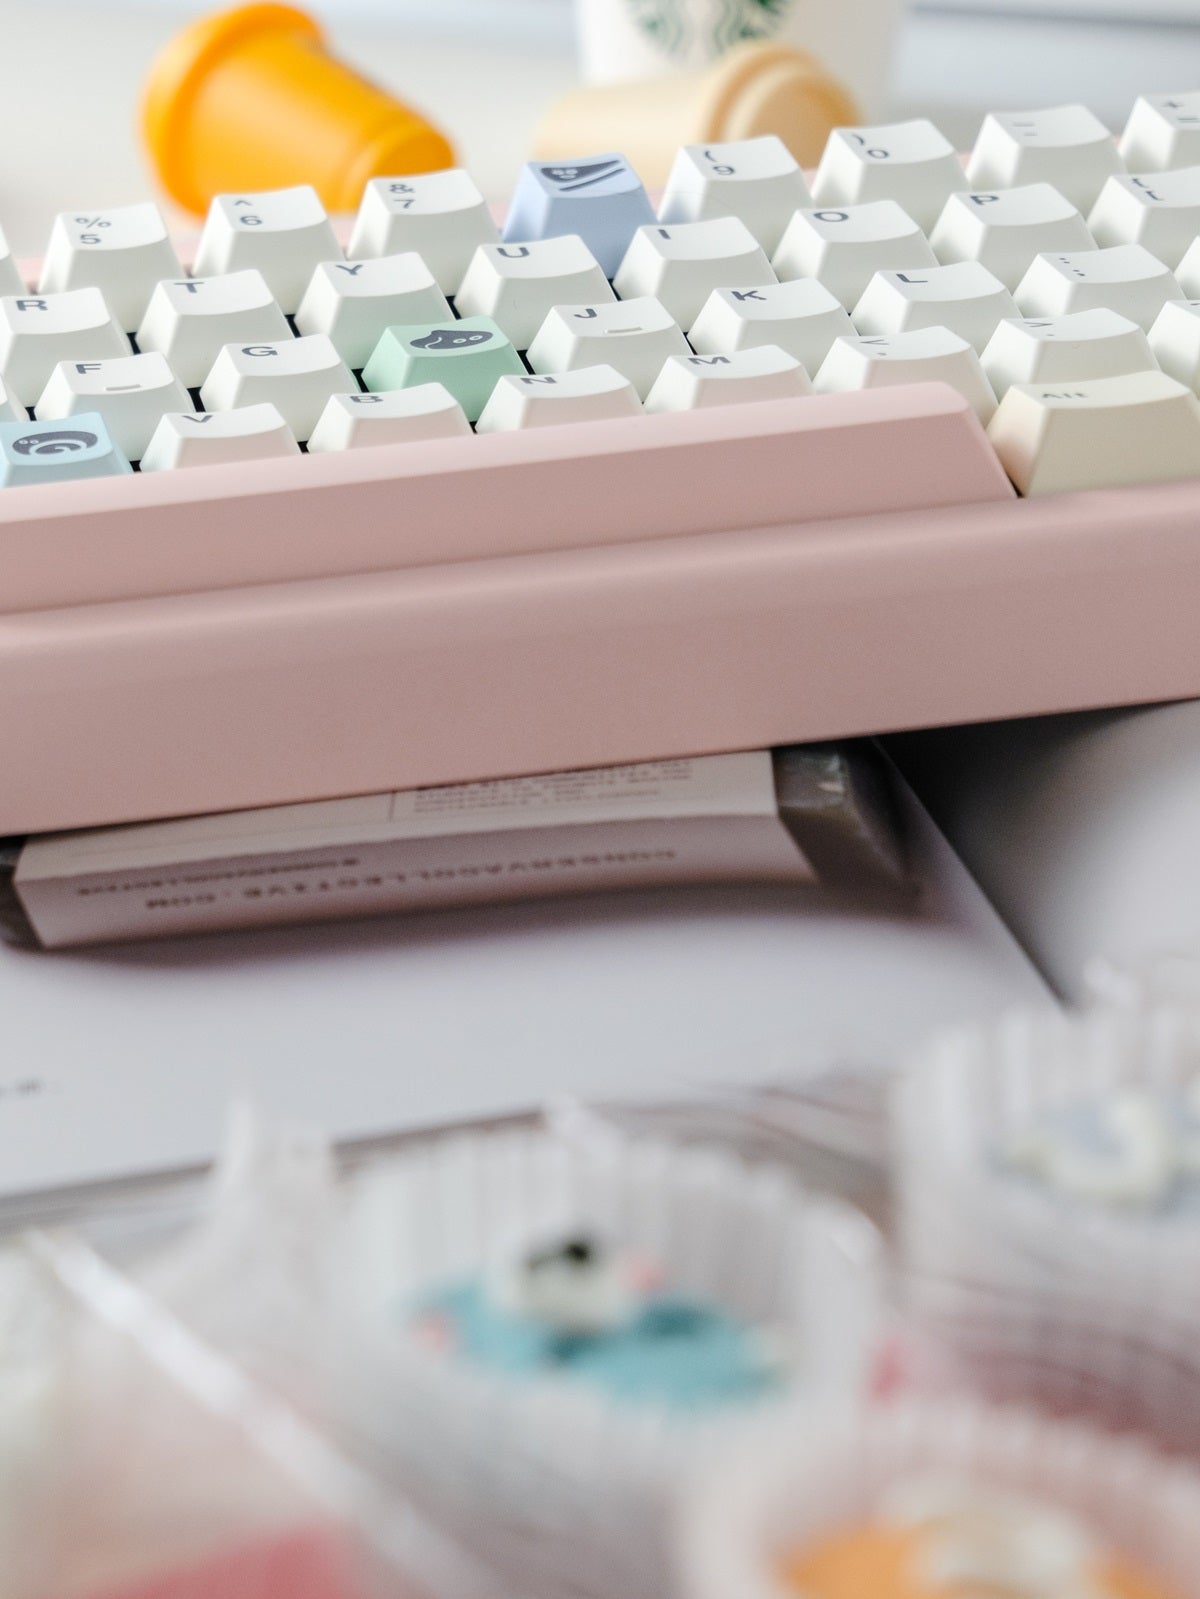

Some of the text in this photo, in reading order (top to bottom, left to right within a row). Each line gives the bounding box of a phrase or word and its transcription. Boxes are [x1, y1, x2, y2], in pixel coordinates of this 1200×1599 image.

[711, 165, 736, 176] 9
[388, 183, 414, 194] &
[393, 198, 415, 209] 7
[969, 195, 1000, 206] P
[239, 215, 263, 226] 6
[812, 211, 850, 223] O
[74, 217, 112, 230] %
[79, 233, 102, 245] 5
[656, 228, 671, 240] I
[495, 246, 530, 259] U
[335, 264, 365, 277] Y
[895, 272, 930, 284] L
[173, 281, 204, 295] T
[730, 289, 768, 302] K
[15, 299, 49, 312] R
[572, 307, 599, 319] J
[241, 345, 279, 357] G
[687, 356, 731, 365] M
[75, 363, 103, 375] F
[519, 376, 557, 386] N
[349, 394, 385, 405] B
[1040, 391, 1091, 400] Alt
[182, 414, 214, 425] V
